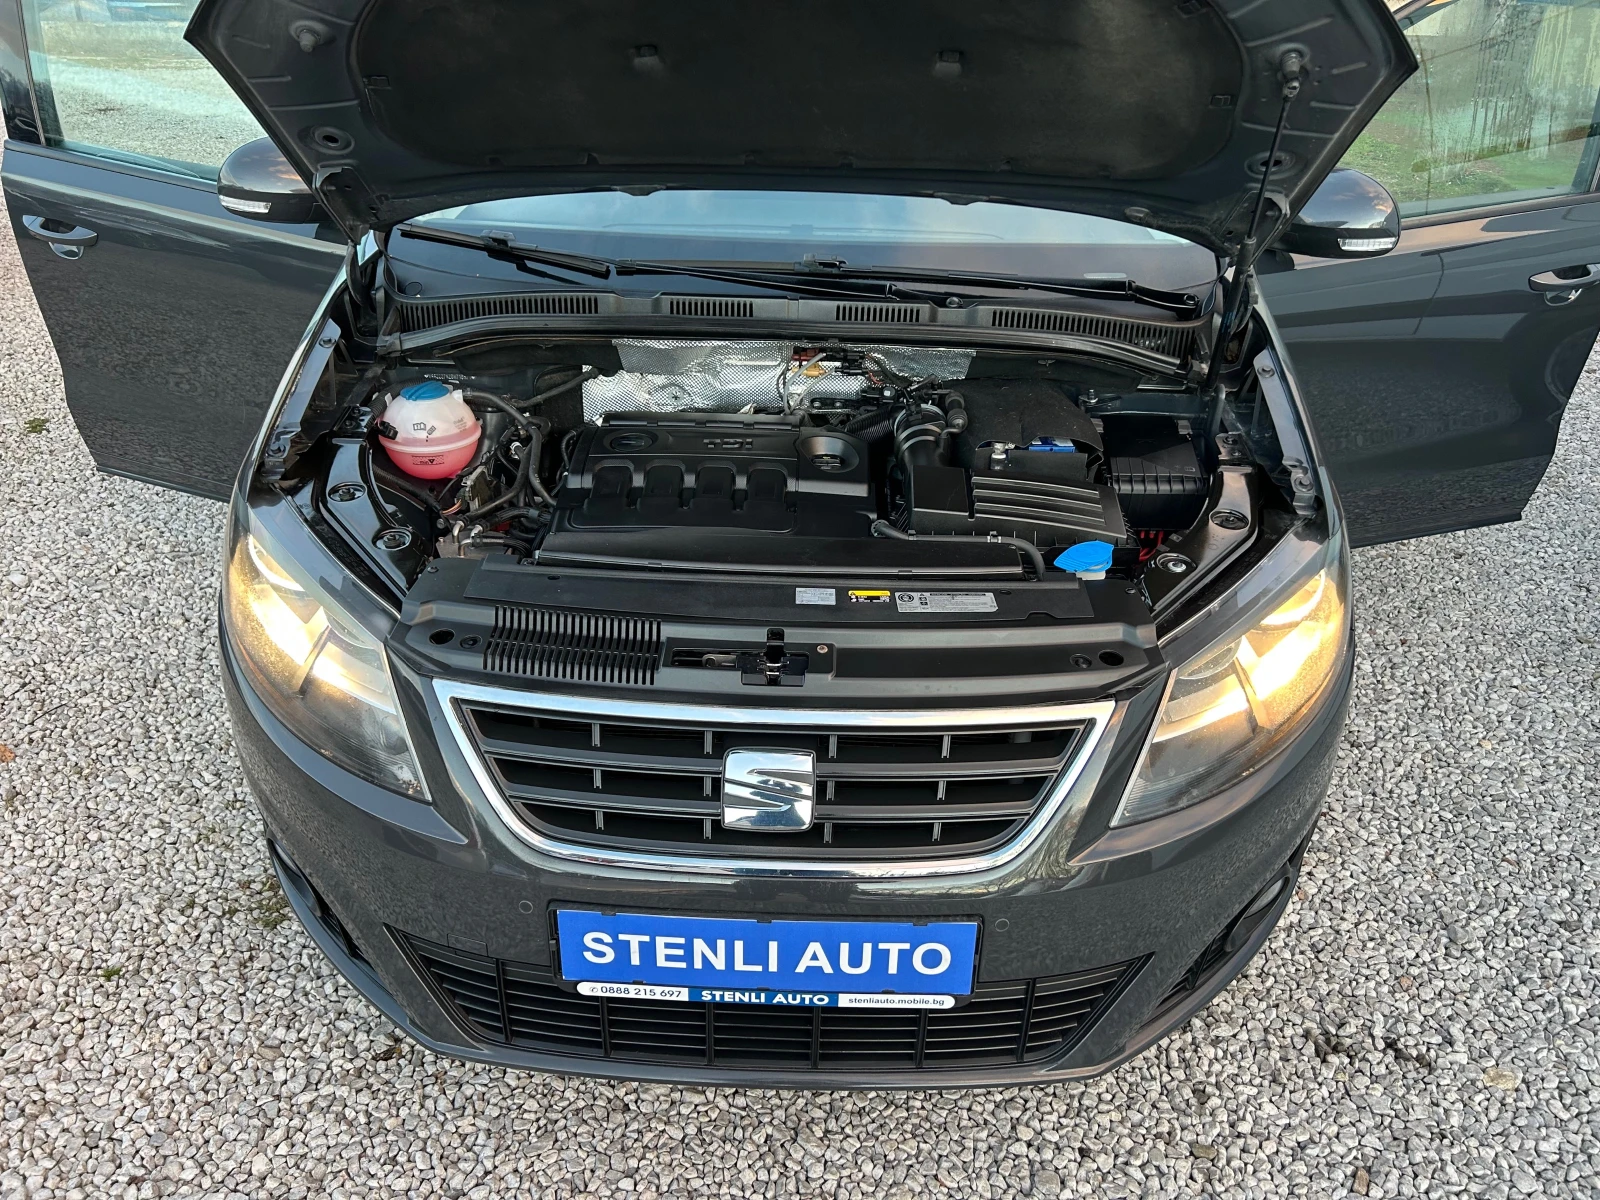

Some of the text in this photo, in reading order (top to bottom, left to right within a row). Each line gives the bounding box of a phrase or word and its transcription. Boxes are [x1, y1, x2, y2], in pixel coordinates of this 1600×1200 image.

[583, 931, 951, 975] STENLI AUTO
[600, 985, 682, 998] 0888 215 697
[701, 990, 829, 1004] STENLI AUTO
[848, 996, 945, 1006] stenliauto.mobile.bg
